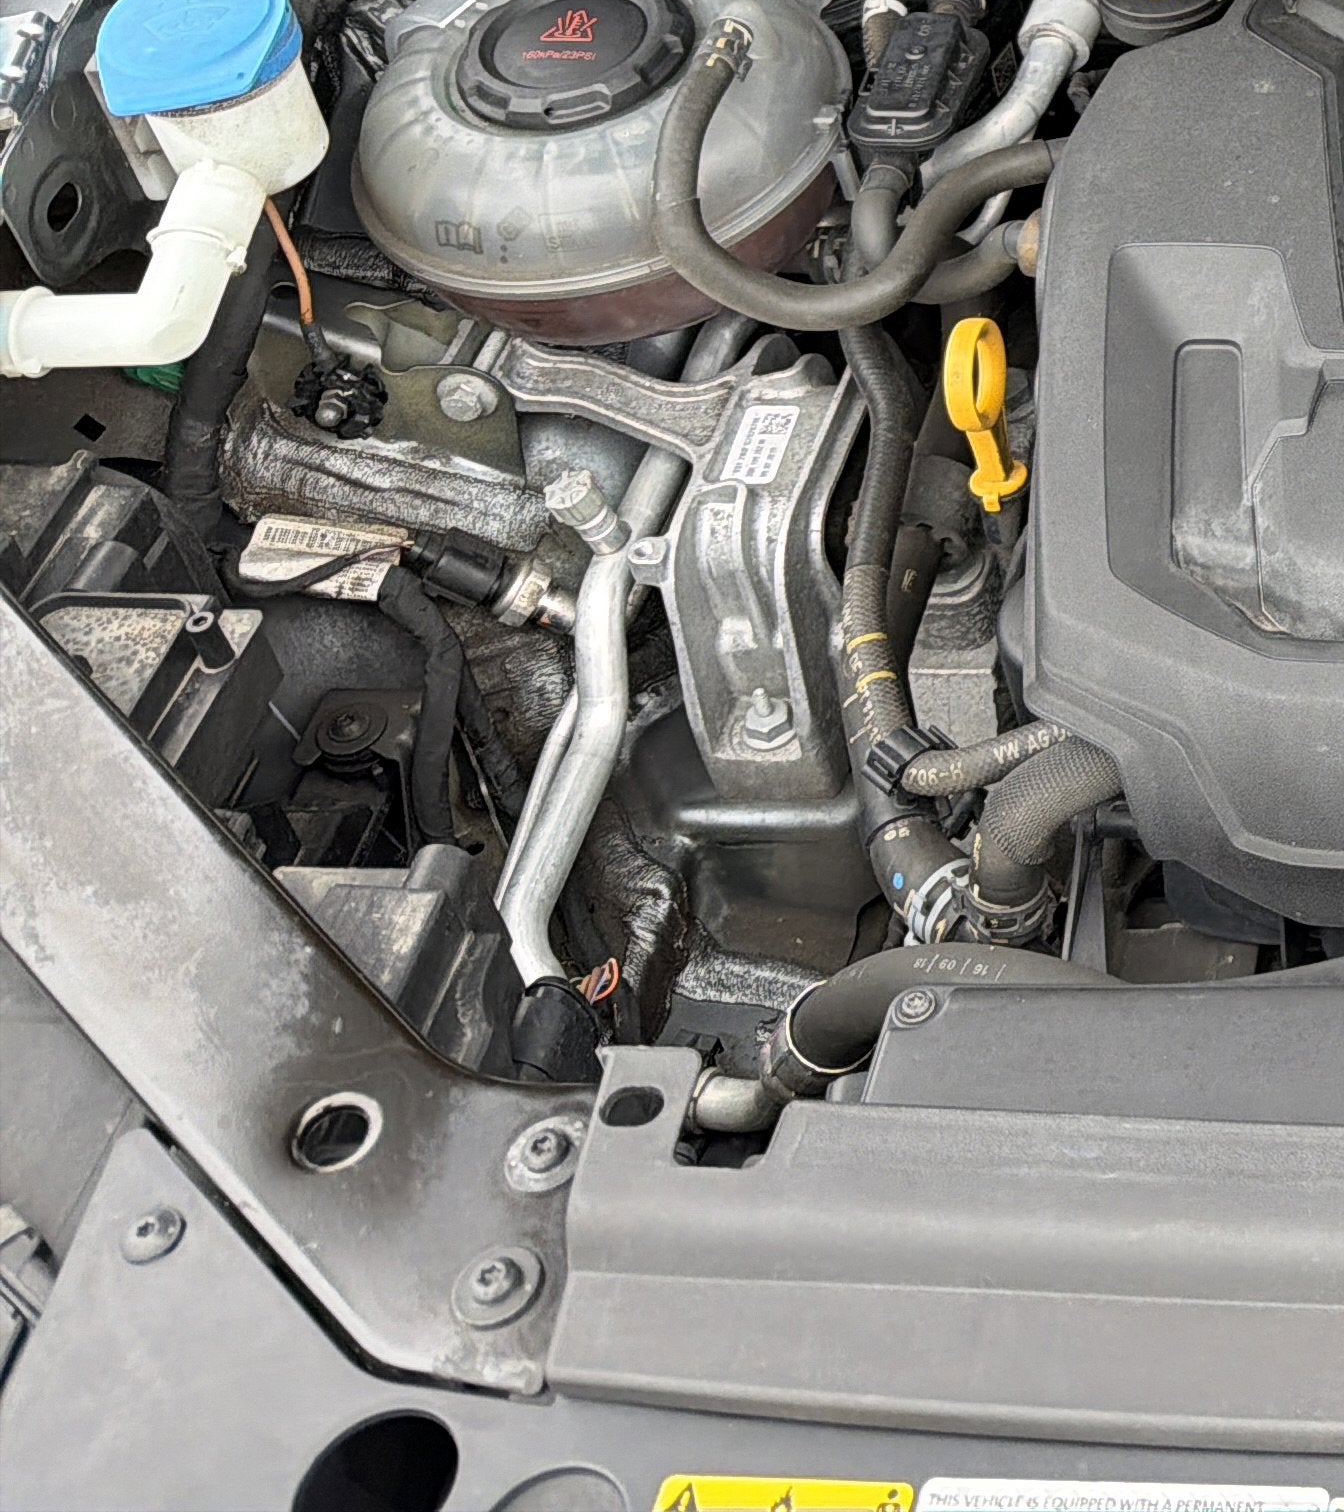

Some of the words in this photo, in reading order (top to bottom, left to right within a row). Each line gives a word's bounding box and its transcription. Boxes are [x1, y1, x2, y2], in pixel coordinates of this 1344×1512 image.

[993, 740, 1020, 765] VW
[1027, 728, 1050, 754] AG
[928, 1493, 960, 1506] THIS
[963, 1494, 1024, 1508] VEHICLE
[1025, 1496, 1039, 1509] IS
[1043, 1496, 1117, 1511] EQUIPPED
[1120, 1497, 1159, 1511] WITH
